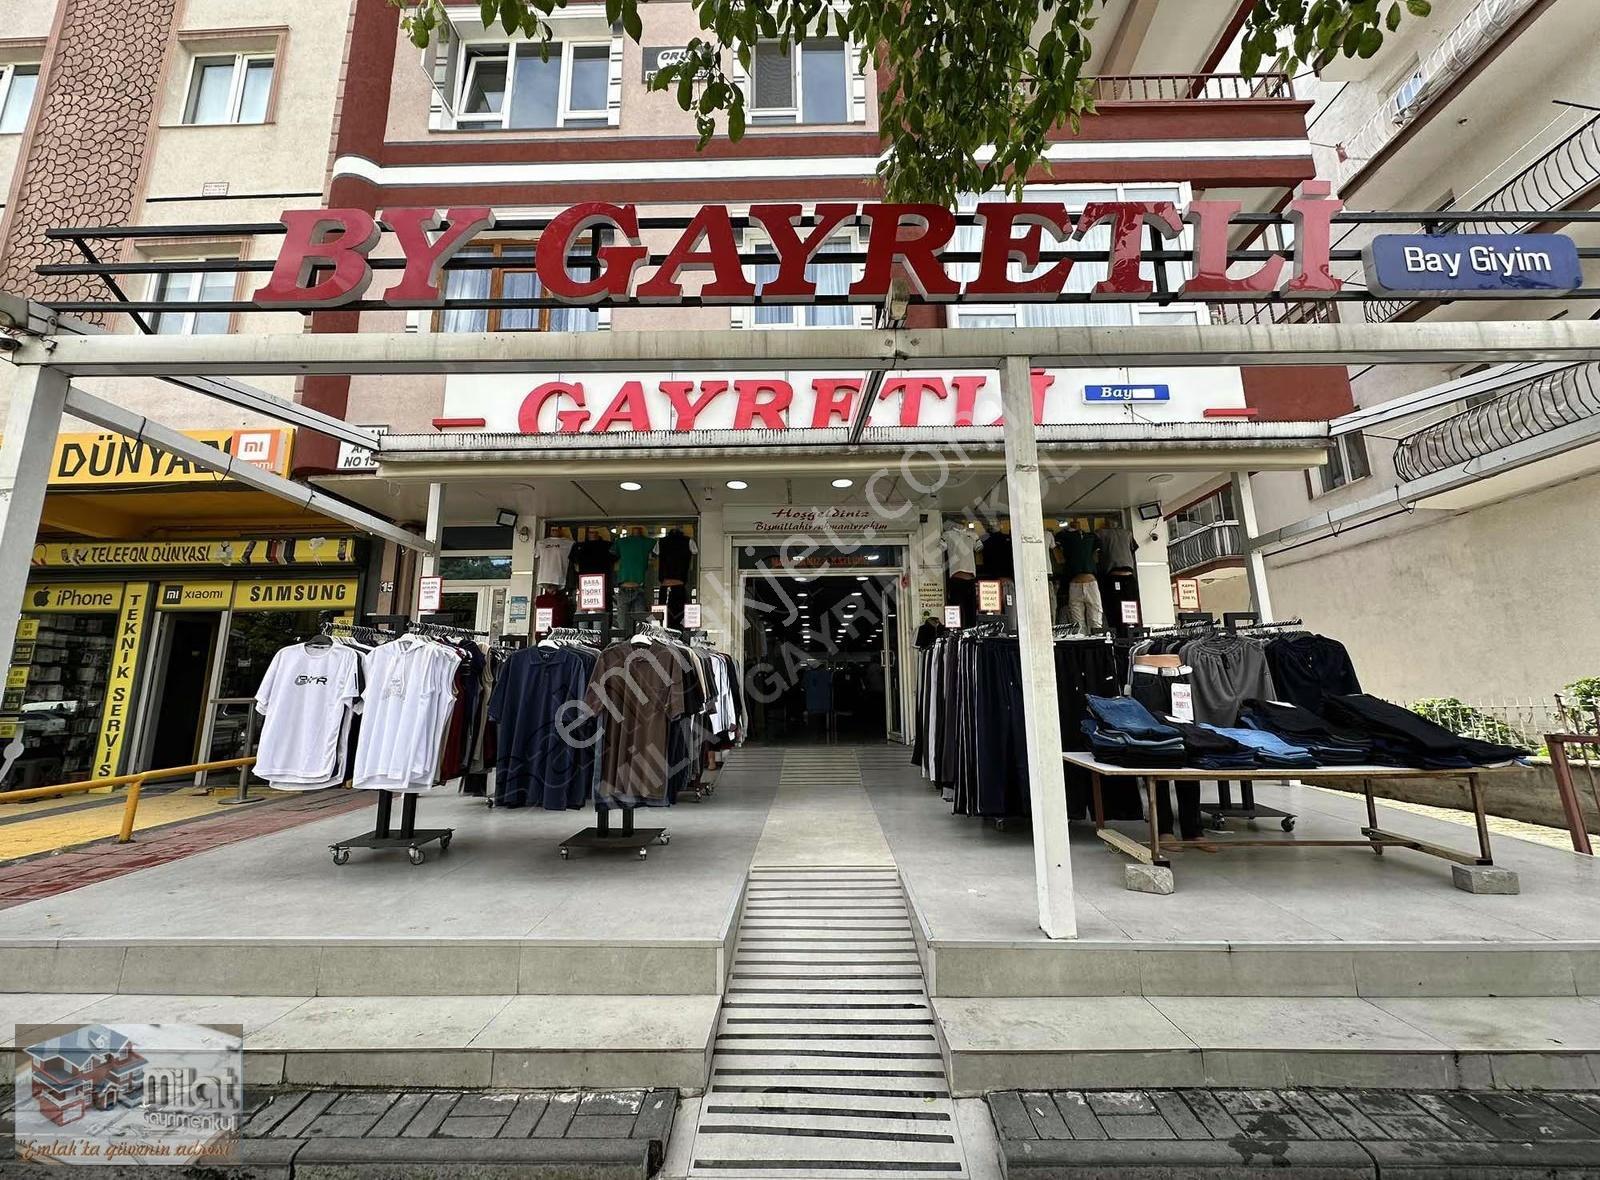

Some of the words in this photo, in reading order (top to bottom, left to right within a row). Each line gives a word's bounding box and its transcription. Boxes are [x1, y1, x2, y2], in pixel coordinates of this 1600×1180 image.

[254, 207, 495, 307] BY
[535, 181, 1342, 303] GAYRETLİ
[1403, 246, 1462, 277] Bay
[1469, 246, 1552, 277] Giyim
[1101, 386, 1132, 399] Bay
[344, 456, 362, 467] NO
[91, 545, 149, 562] TELEFON
[151, 543, 211, 562] DÜNYASI
[184, 588, 223, 599] xiaomi
[250, 584, 346, 602] SAMSUNG
[381, 581, 394, 593] 15
[56, 589, 113, 606] iPhone
[116, 594, 141, 679] TEKNİK
[98, 687, 126, 777] SERVİS
